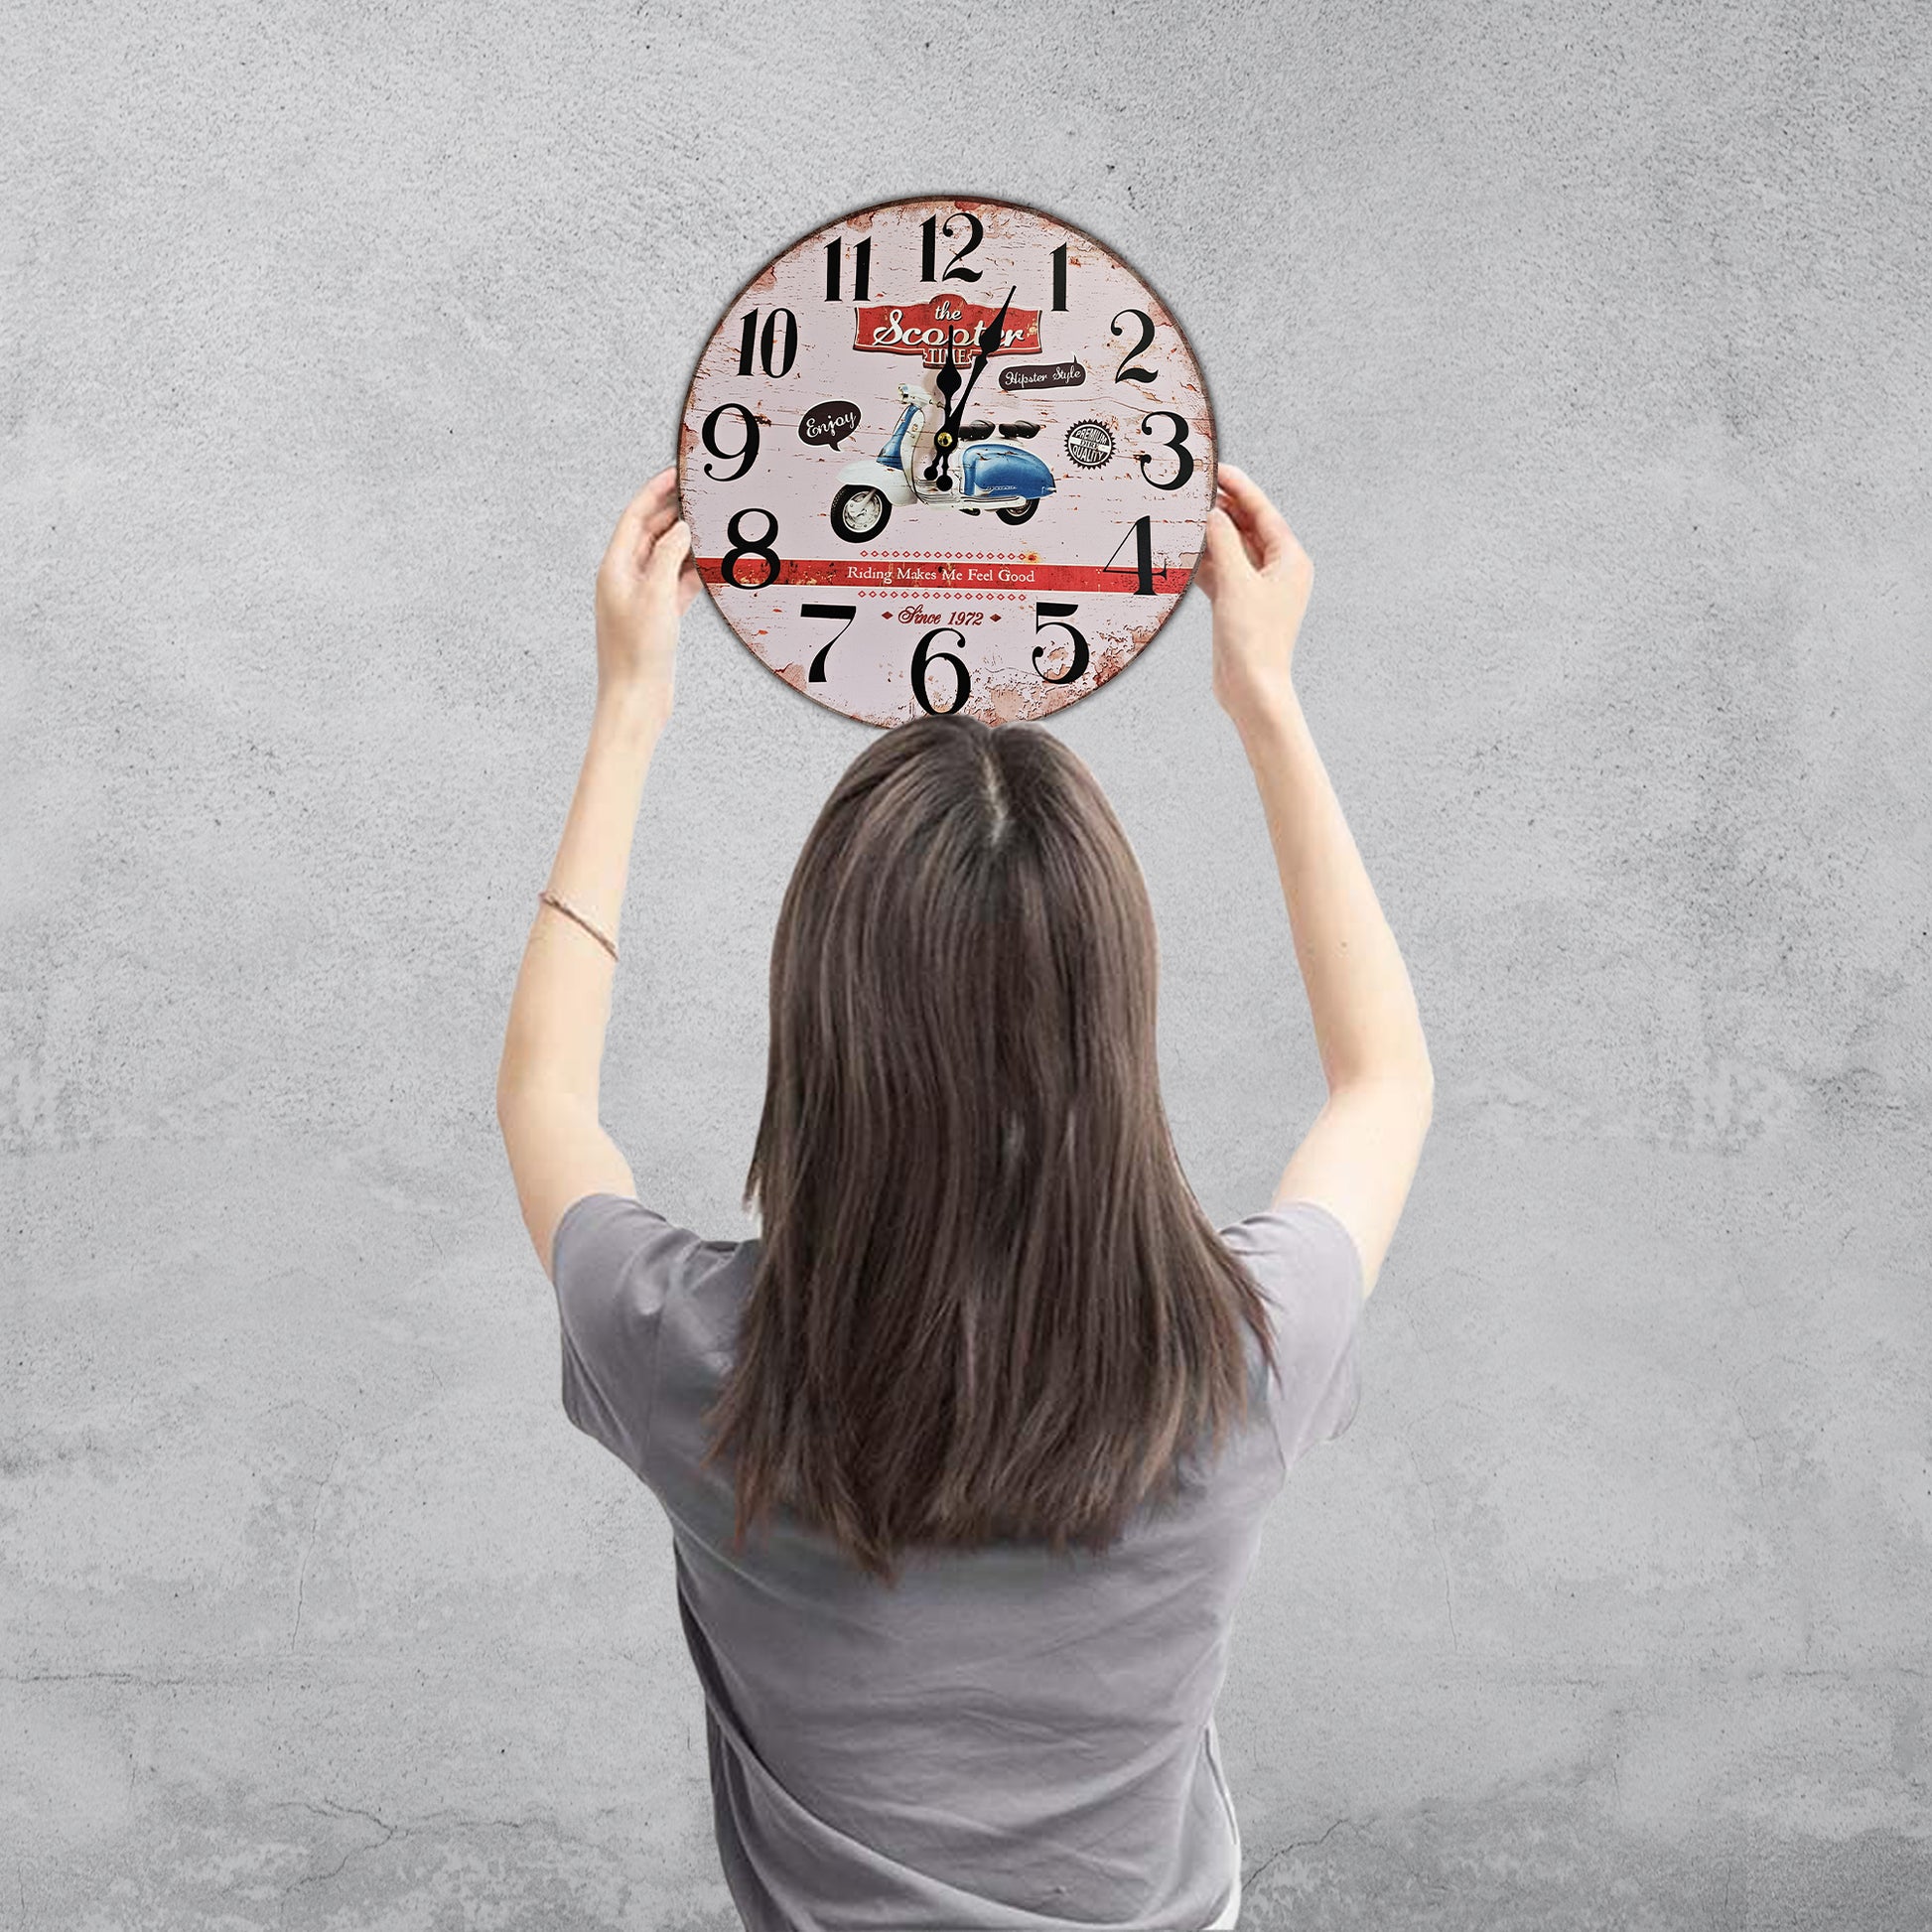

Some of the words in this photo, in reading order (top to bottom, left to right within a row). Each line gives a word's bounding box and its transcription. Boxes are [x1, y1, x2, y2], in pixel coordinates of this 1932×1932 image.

[823, 236, 872, 302] 11
[919, 212, 984, 283] 12
[1049, 242, 1069, 312] 1
[737, 308, 798, 378] 10
[934, 301, 962, 321] the
[1110, 309, 1159, 383] 2
[1005, 372, 1047, 388] Hipster
[1052, 366, 1081, 383] Style
[701, 403, 760, 482] 9
[806, 412, 856, 438] Enjoy
[1072, 445, 1104, 462] QUALITY
[1075, 428, 1108, 444] PREMIUM
[1140, 411, 1194, 490] 3
[721, 508, 781, 590] 8
[847, 566, 893, 584] Riding
[897, 568, 937, 581] Makes
[942, 569, 963, 581] Me
[968, 569, 994, 582] Feel
[998, 570, 1035, 583] Good
[1102, 515, 1168, 596] 4
[800, 604, 857, 683] 7
[897, 604, 941, 625] Since
[947, 612, 984, 626] 1972
[1031, 602, 1090, 685] 5
[910, 627, 971, 717] 6
